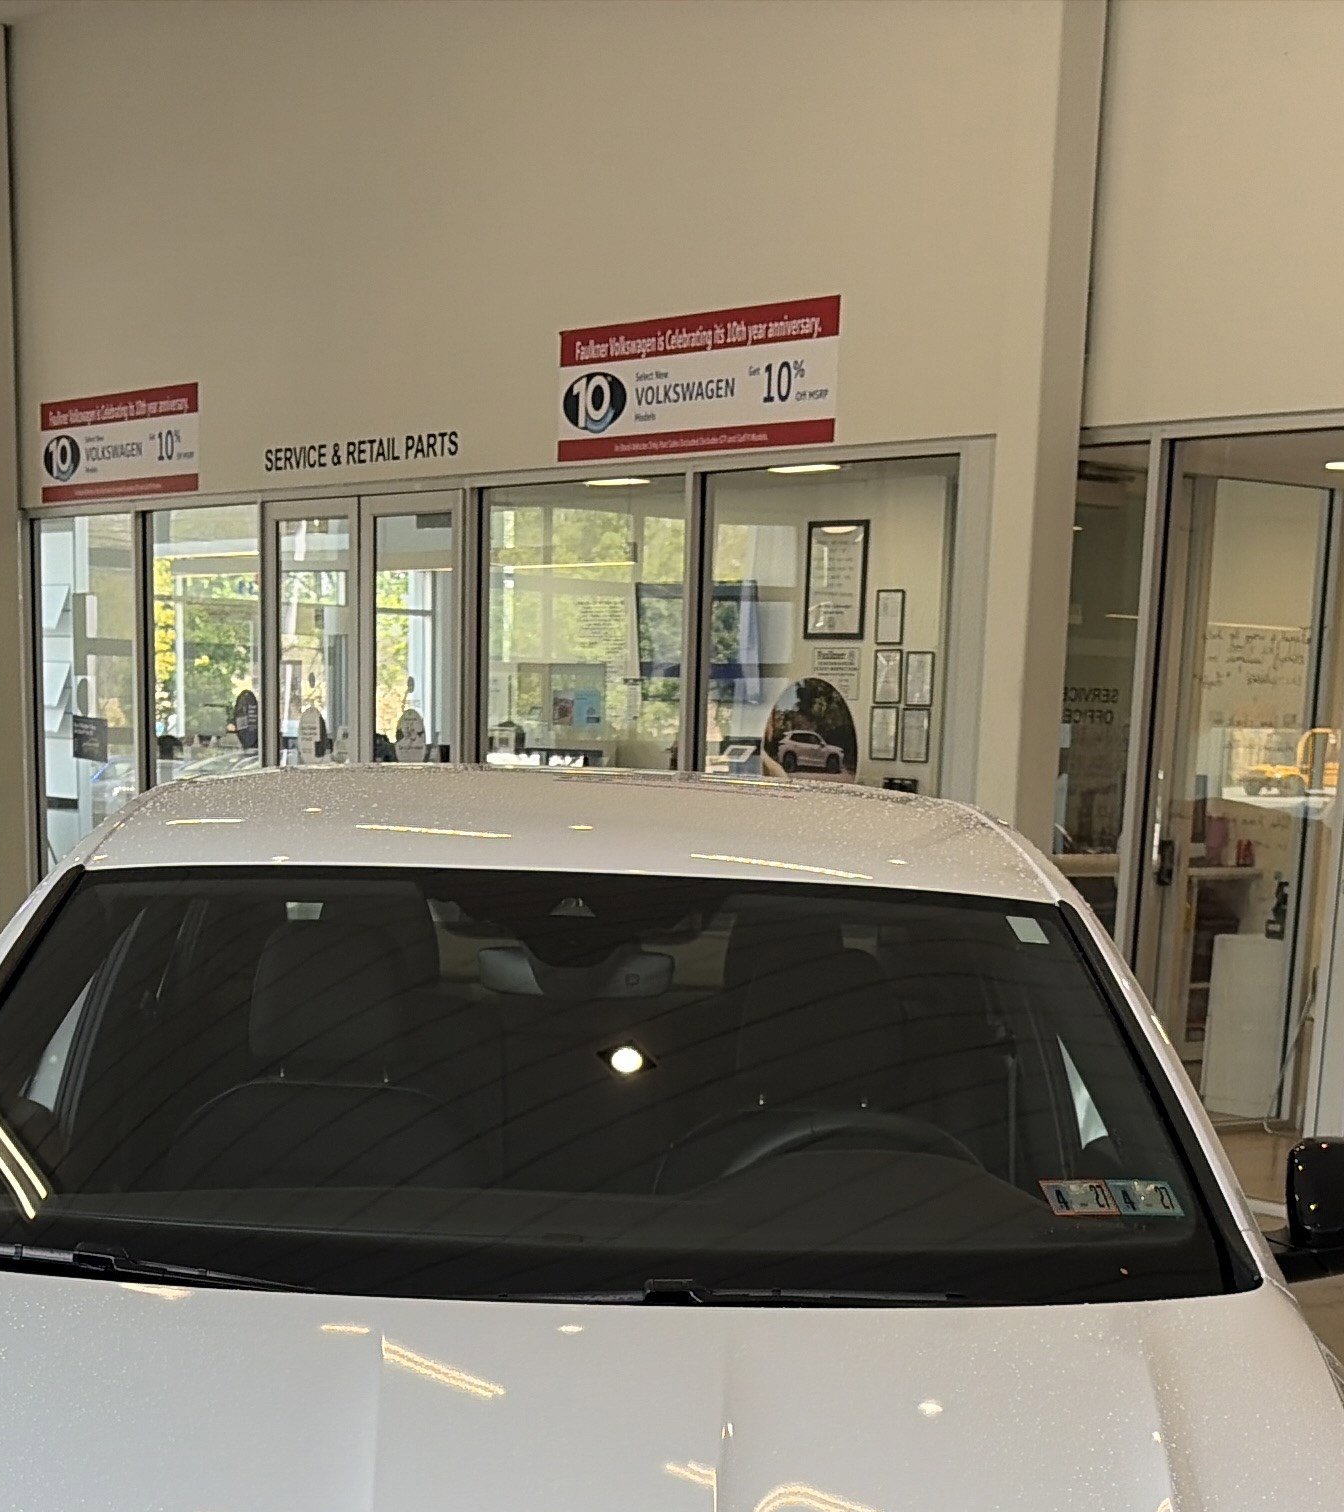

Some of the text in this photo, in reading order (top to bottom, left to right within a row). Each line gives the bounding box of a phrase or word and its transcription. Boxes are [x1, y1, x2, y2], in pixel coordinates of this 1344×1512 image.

[575, 314, 822, 361] Faulkner Volkswagen is Celebrating its 10th year anniversary.
[635, 377, 735, 406] VOLKSWAGEN
[85, 442, 143, 462] VOLKSWAGEN
[265, 431, 459, 472] SERVICE & RETAIL PARTS
[1055, 1184, 1110, 1211] 4 27
[1121, 1185, 1175, 1211] 4 27
